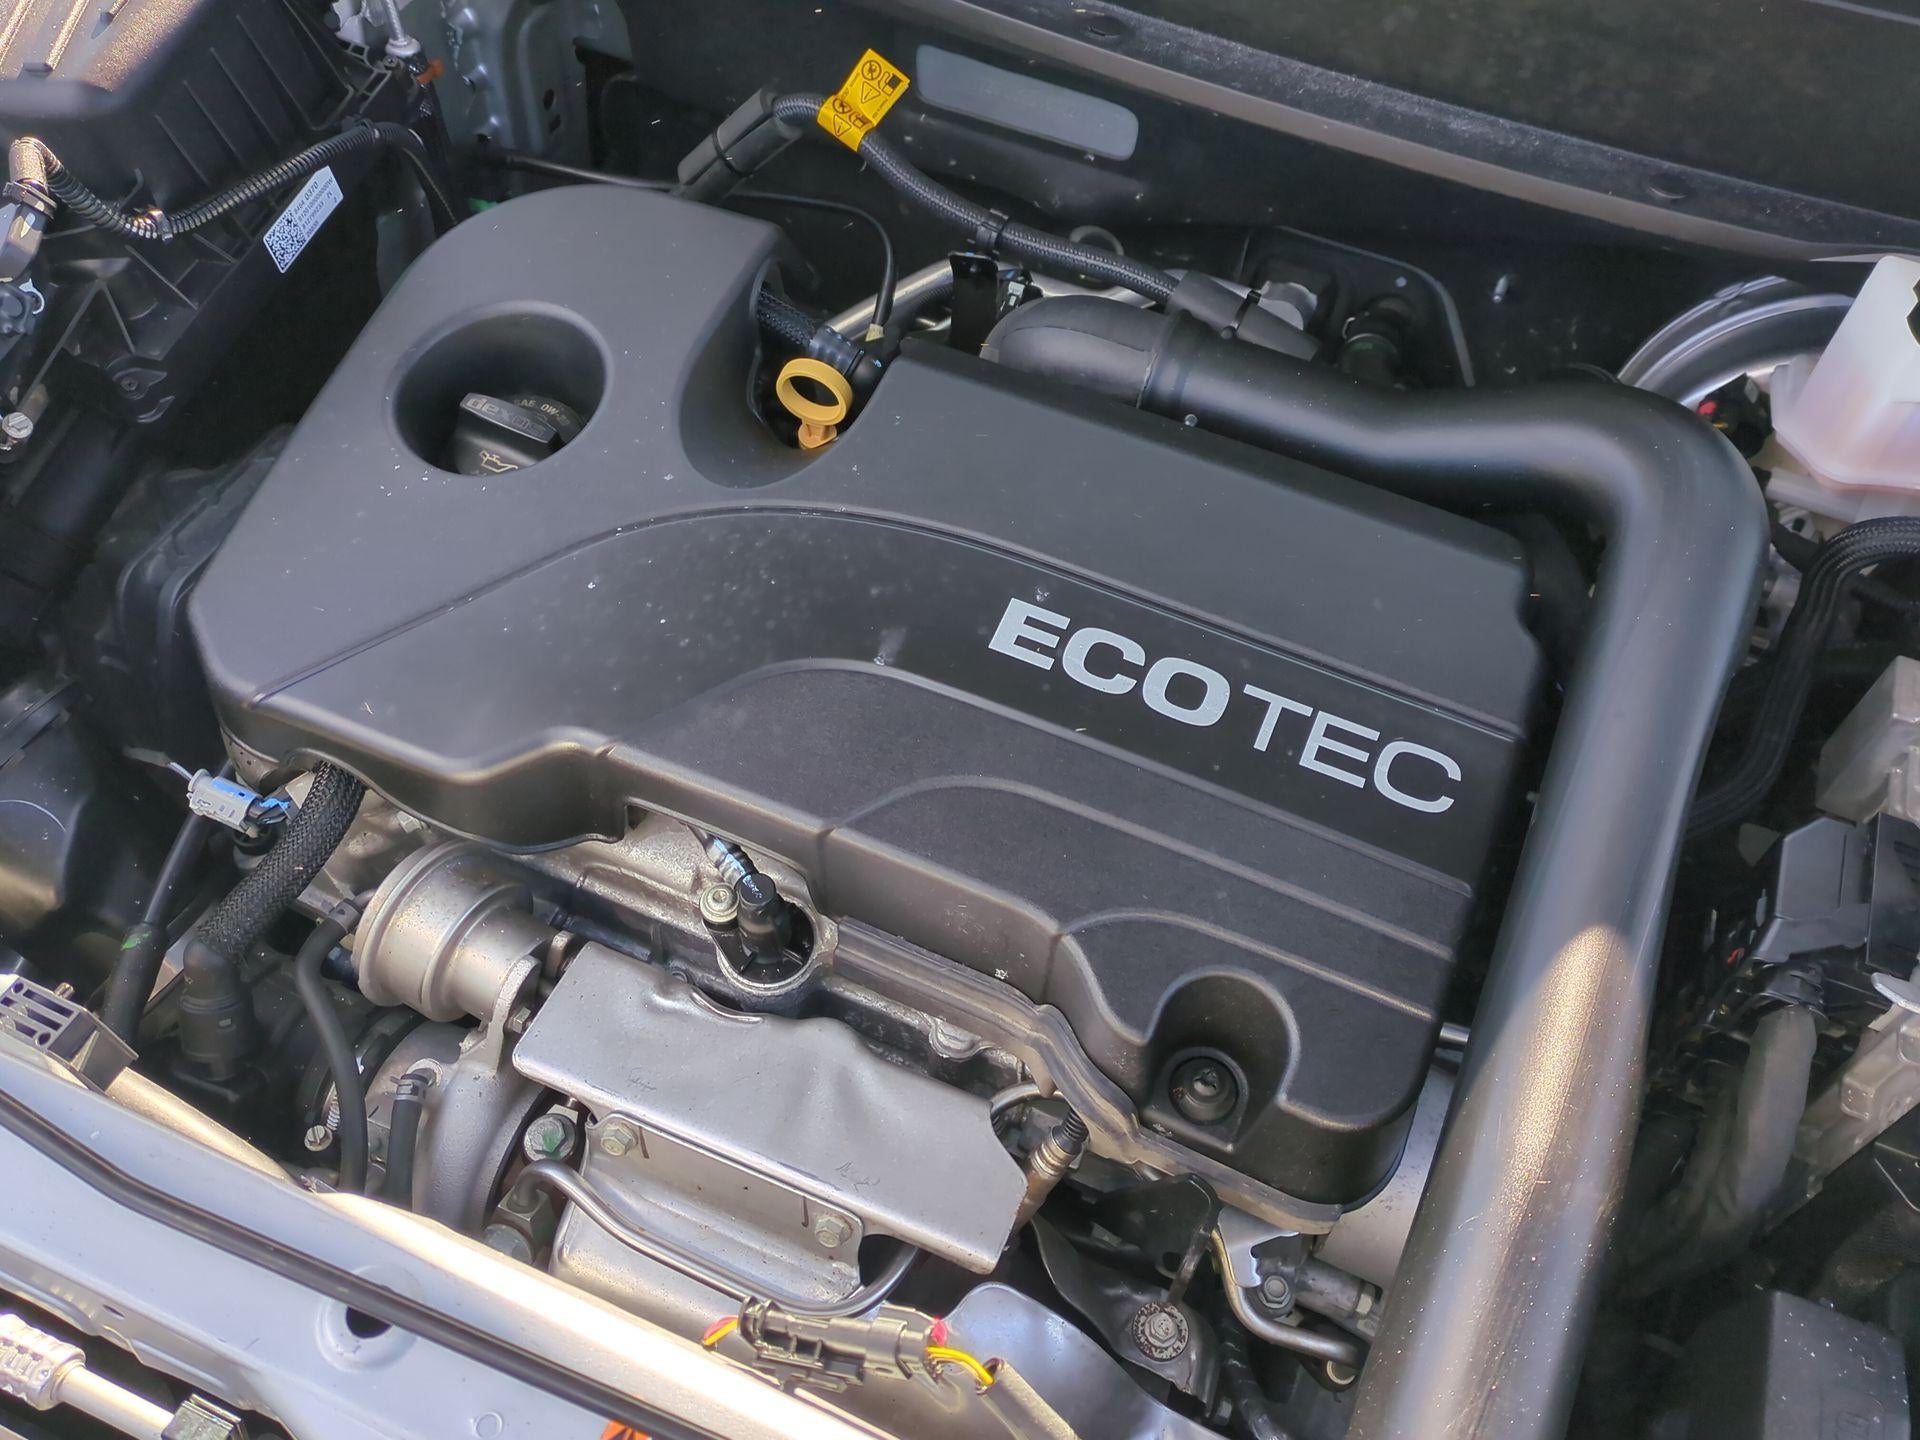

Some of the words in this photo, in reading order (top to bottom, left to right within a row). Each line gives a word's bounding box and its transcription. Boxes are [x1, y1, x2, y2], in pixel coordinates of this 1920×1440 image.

[304, 181, 319, 201] 0370
[466, 398, 546, 438] dexos
[988, 598, 1462, 814] ECOTEC
